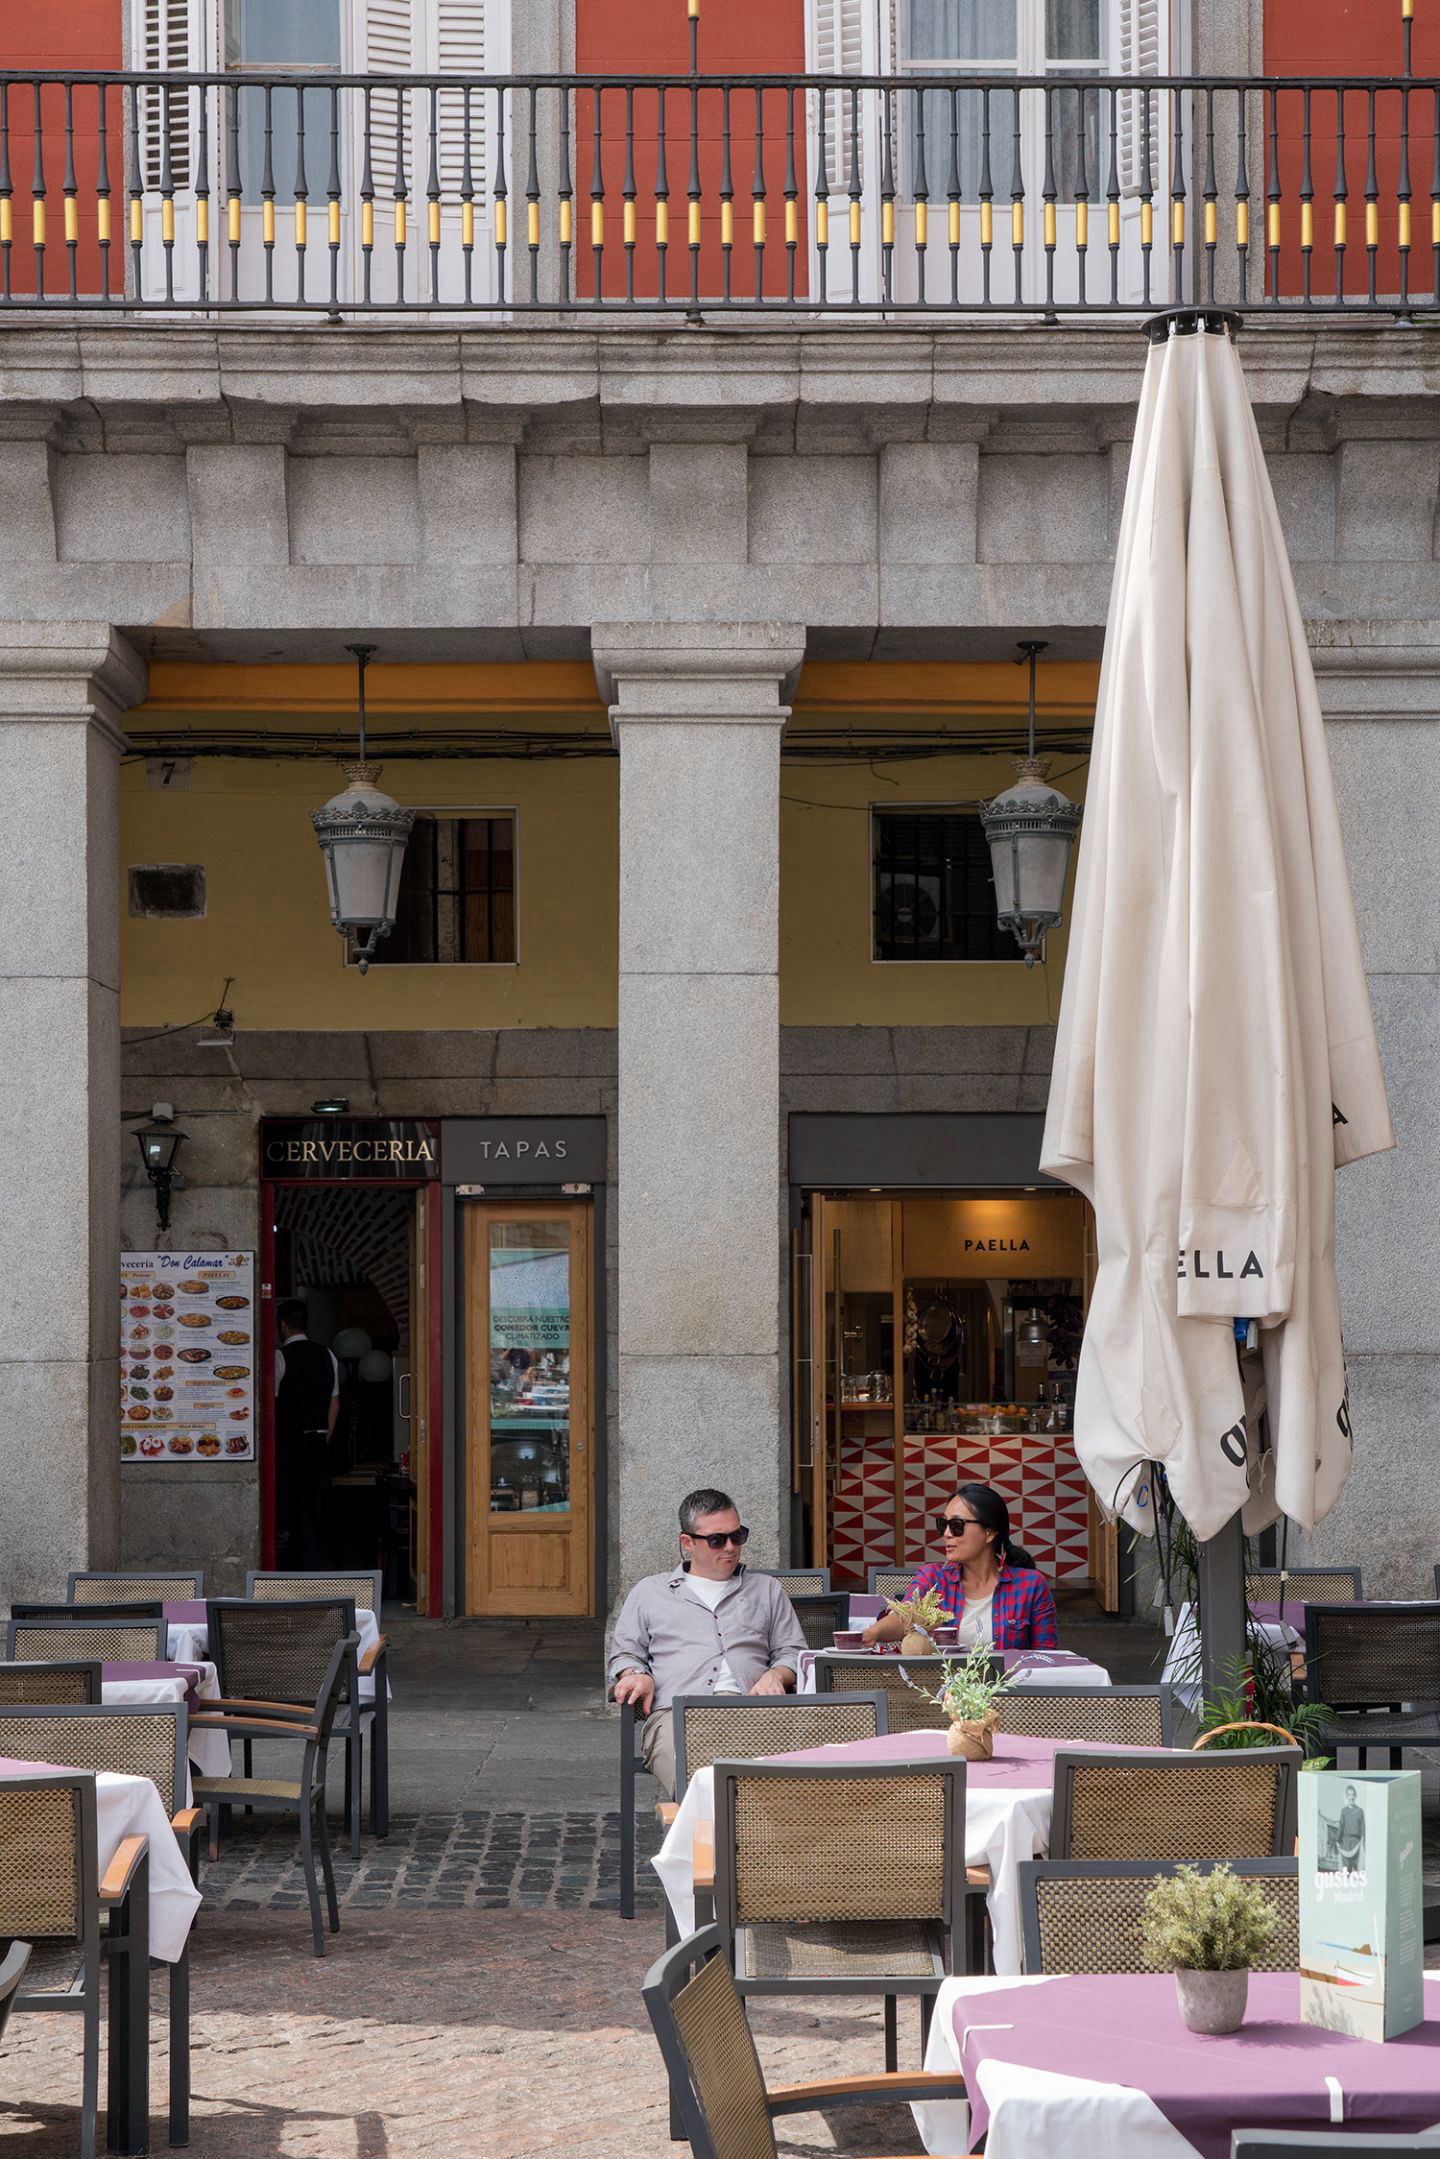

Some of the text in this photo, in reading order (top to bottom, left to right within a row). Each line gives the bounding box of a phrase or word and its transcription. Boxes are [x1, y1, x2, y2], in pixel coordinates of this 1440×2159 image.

[162, 762, 176, 785] 7
[266, 1140, 434, 1162] CERVECERIA
[480, 1140, 567, 1159] TAPAS
[964, 1239, 1030, 1251] PAELLA
[493, 1315, 534, 1323] DESCUBRA
[505, 1332, 560, 1340] CLIMATIZADO
[1314, 1866, 1368, 1902] gustos
[1334, 1889, 1364, 1904] Madrid
